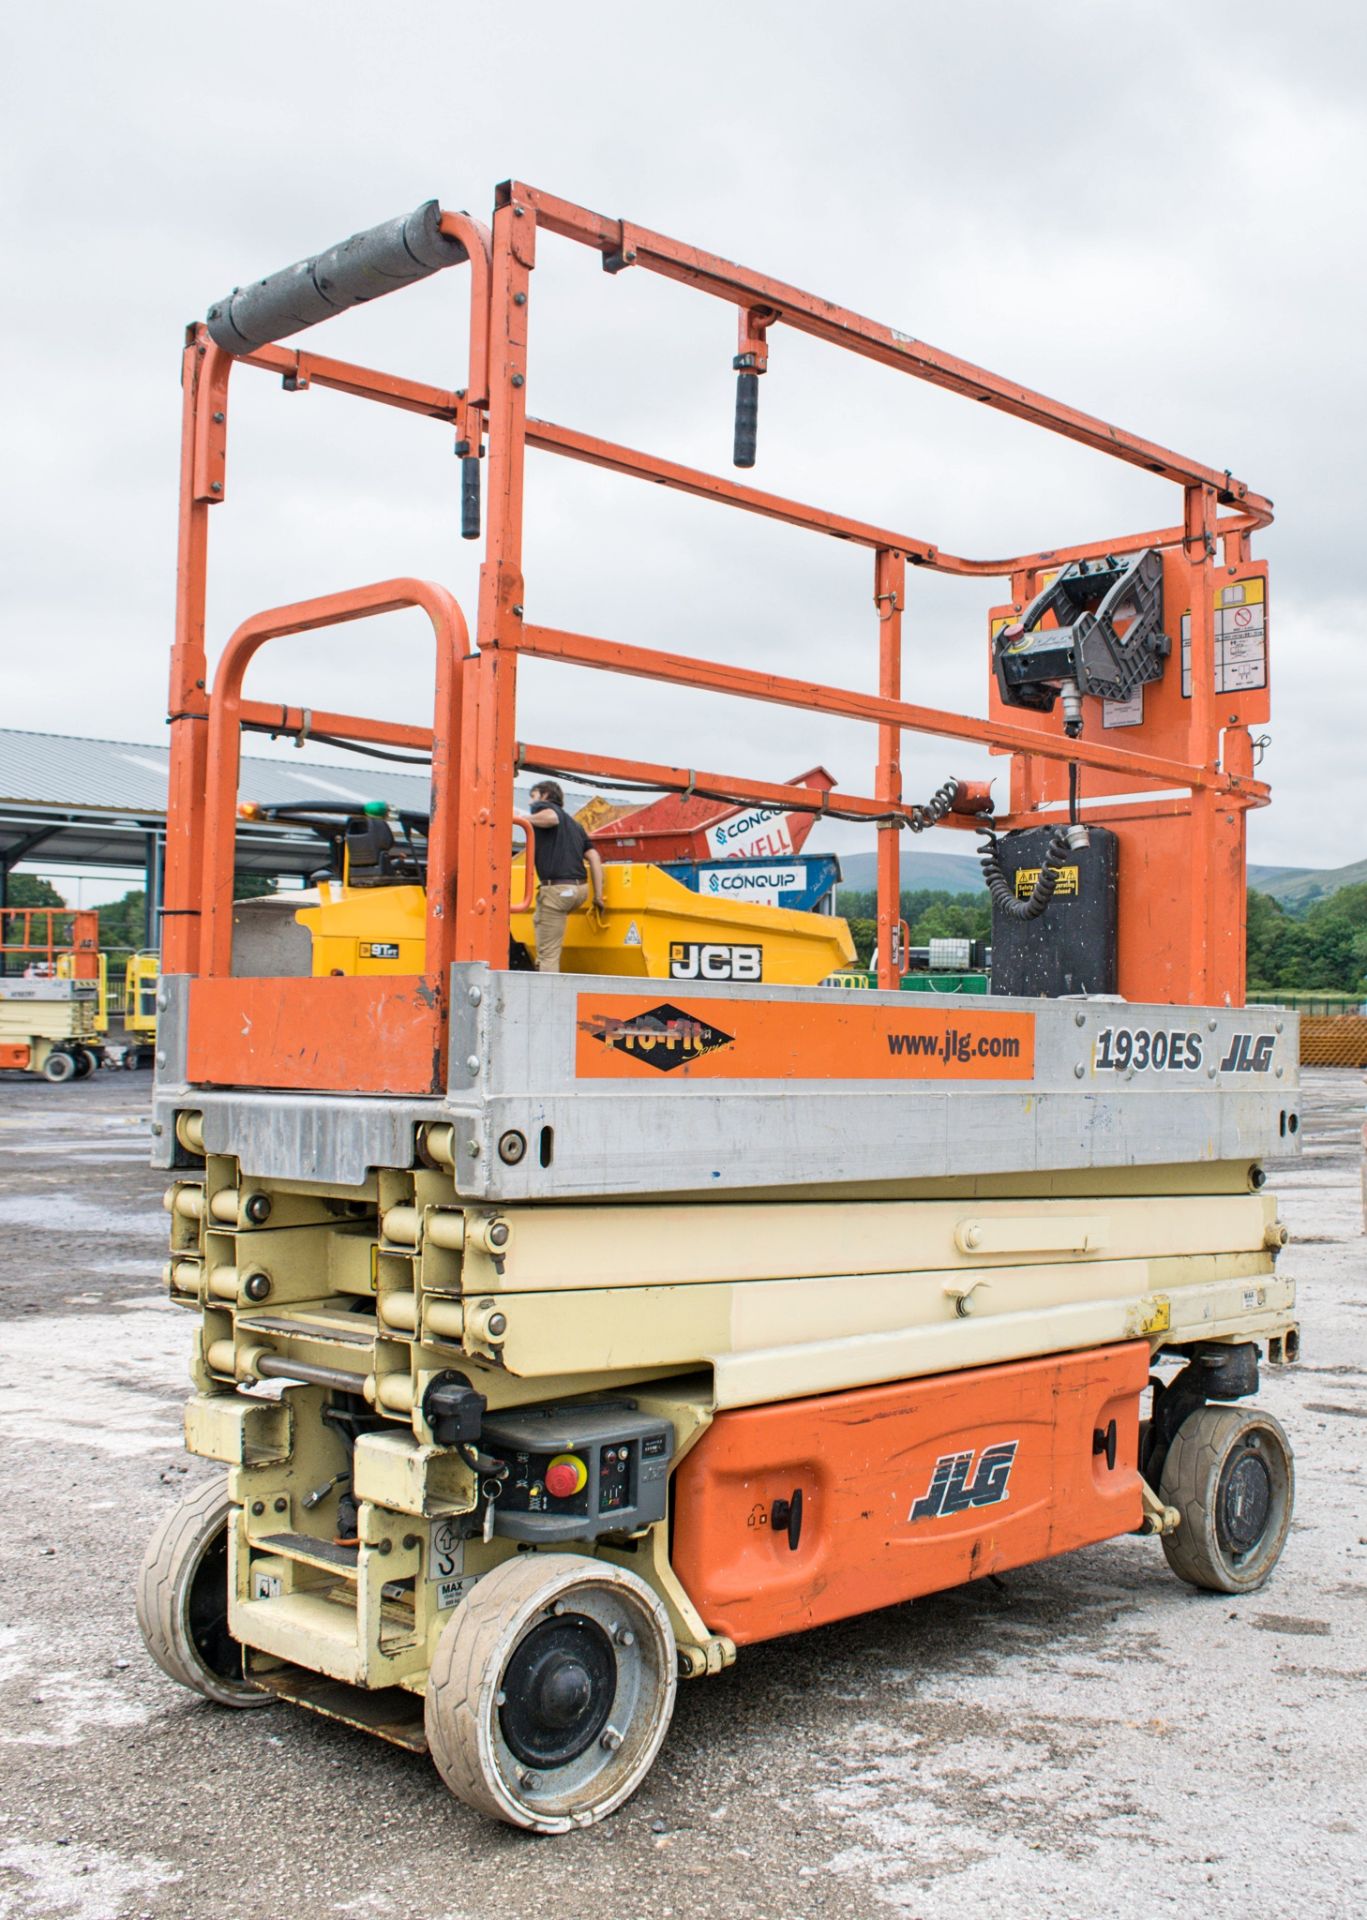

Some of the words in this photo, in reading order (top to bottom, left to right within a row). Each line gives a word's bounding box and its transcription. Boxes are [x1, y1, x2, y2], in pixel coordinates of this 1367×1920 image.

[728, 809, 783, 838] CONQ
[728, 829, 790, 858] VELL
[721, 874, 795, 890] CONQUIP
[671, 945, 761, 980] JCB
[887, 1029, 1020, 1062] www.jlg.com
[1095, 1028, 1202, 1071] 1930ES
[1219, 1033, 1277, 1074] JLG
[908, 1440, 1019, 1522] JLG
[442, 1581, 463, 1594] MAX
